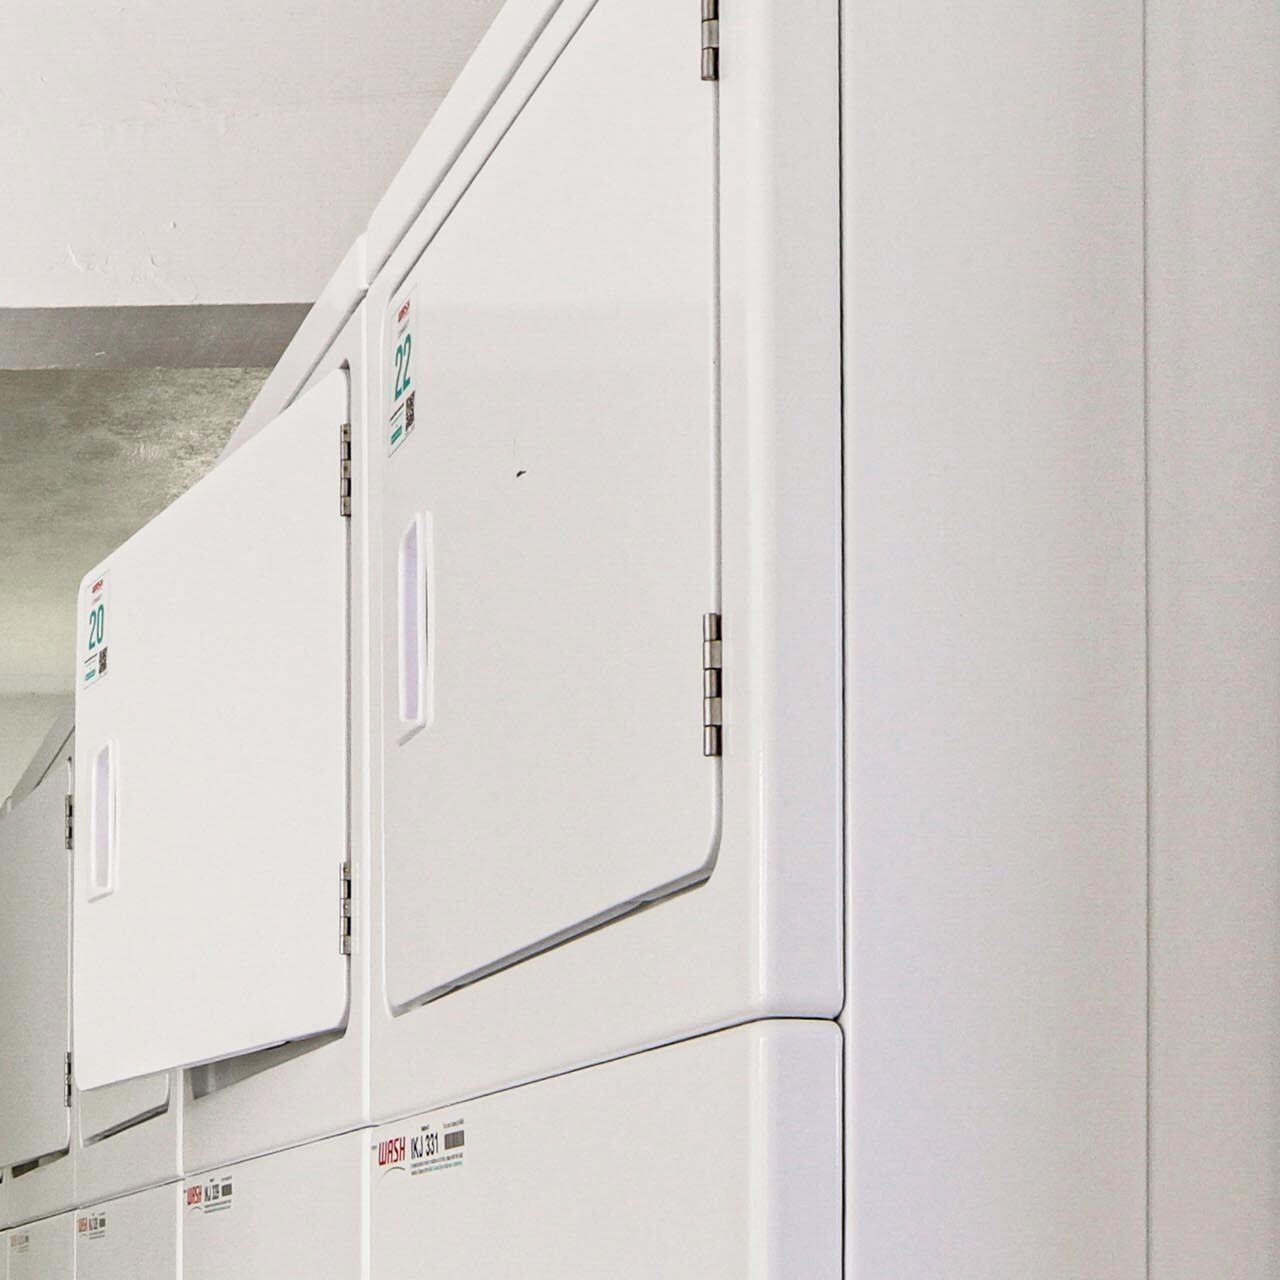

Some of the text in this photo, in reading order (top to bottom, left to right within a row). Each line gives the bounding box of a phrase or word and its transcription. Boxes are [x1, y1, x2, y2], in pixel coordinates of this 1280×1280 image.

[394, 333, 411, 401] 22
[89, 604, 104, 651] 20
[378, 1131, 439, 1166] WASH IKJ 331
